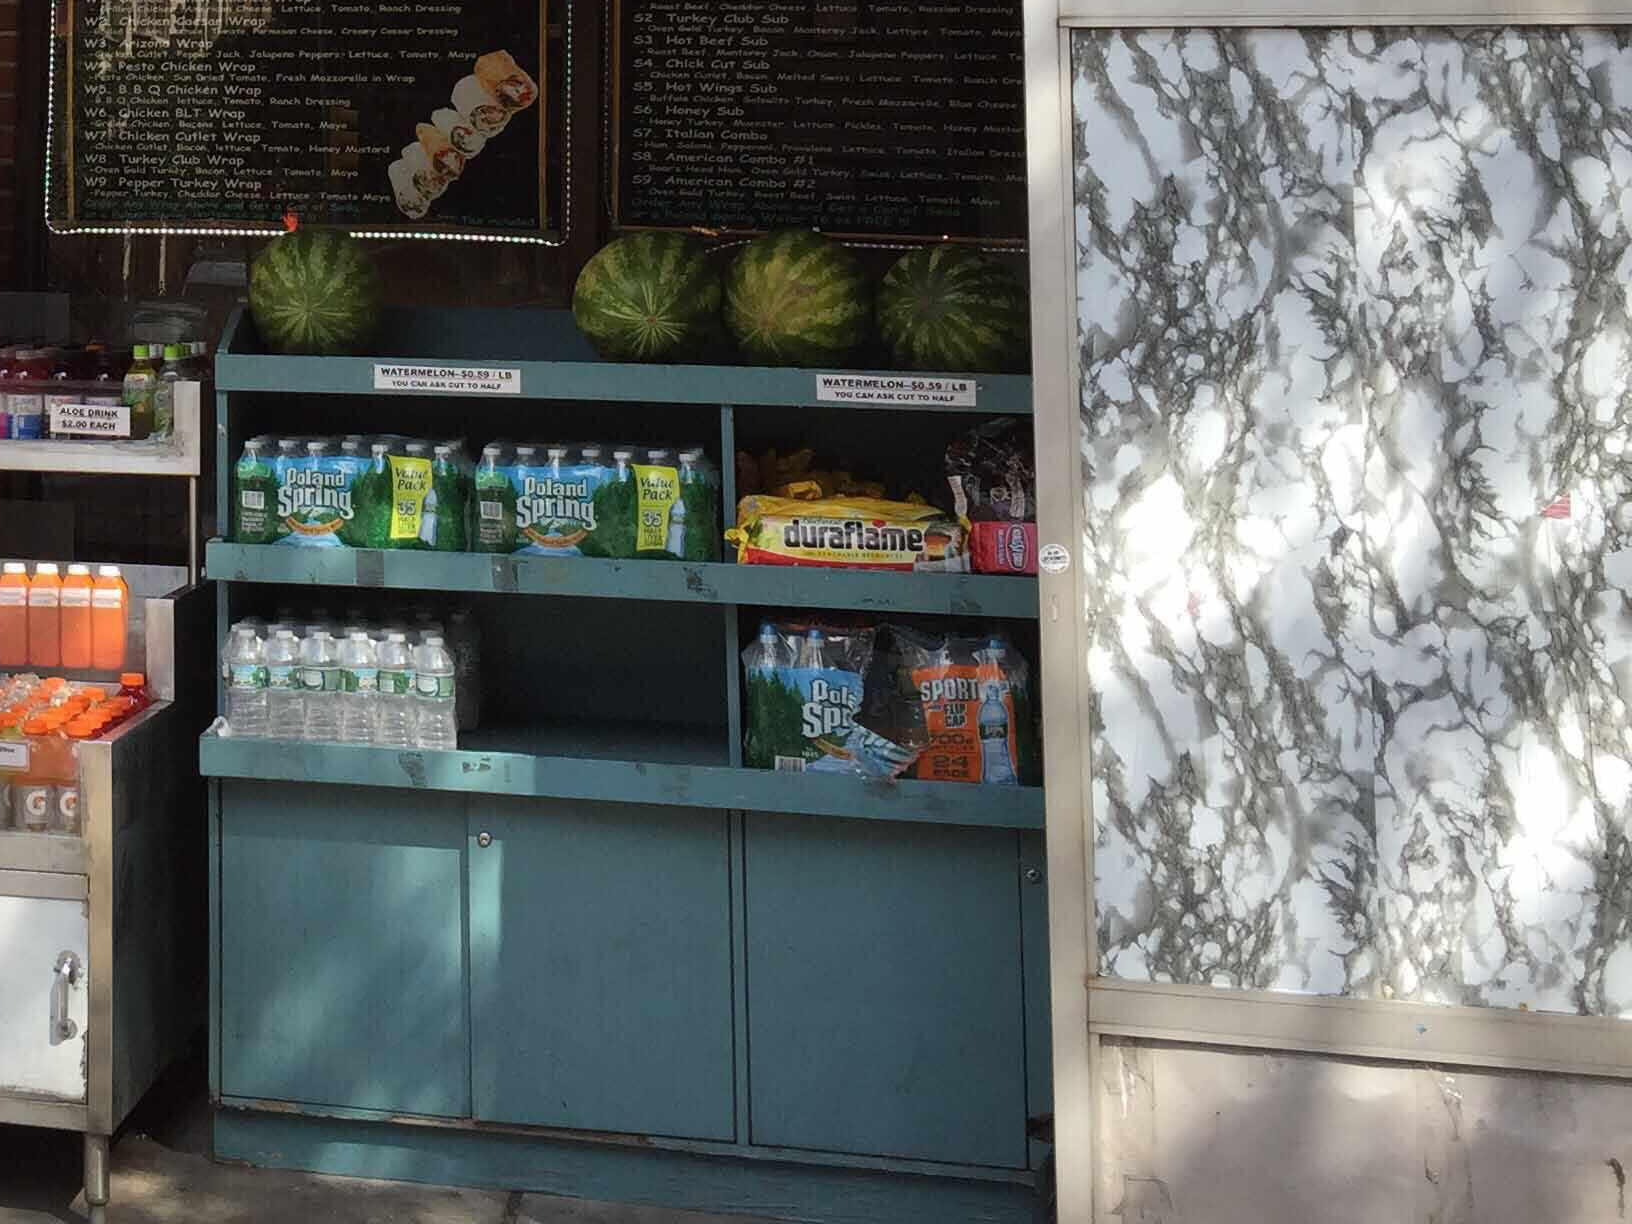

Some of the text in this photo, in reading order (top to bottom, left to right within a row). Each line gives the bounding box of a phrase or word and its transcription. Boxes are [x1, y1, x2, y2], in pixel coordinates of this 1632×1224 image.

[228, 17, 267, 29] Wrap
[665, 13, 718, 27] Turkey
[723, 13, 755, 23] Club
[760, 14, 789, 24] Sub
[176, 38, 214, 50] Wrap
[665, 35, 694, 45] Hot
[699, 35, 734, 45] Beef
[740, 36, 768, 46] Sub
[118, 62, 156, 72] Pesto
[160, 62, 212, 72] Chicken
[218, 62, 256, 74] Wrap
[665, 59, 704, 68] Chick
[742, 59, 770, 70] Sub
[166, 84, 218, 95] Chicken
[224, 84, 262, 97] Wrap
[665, 82, 693, 92] Hot
[699, 82, 744, 95] Wings
[749, 83, 778, 94] Sub
[84, 107, 246, 121] W6 Chicken BLT Wrap
[665, 105, 710, 117] Honey
[717, 106, 744, 116] Sub
[119, 131, 168, 141] Chicken
[175, 131, 216, 141] Cutlet
[223, 132, 261, 144] Wrap
[665, 128, 714, 138] Italian
[720, 128, 768, 140] Combo
[84, 154, 244, 167] W8 Turkey Club Wrap
[665, 152, 734, 163] American
[739, 152, 787, 164] Combo
[84, 177, 262, 191] W9 Pepper Turkey Wrap
[665, 175, 734, 186] American
[739, 176, 787, 188] Combo
[498, 371, 512, 380] LB
[952, 382, 968, 391] LB
[876, 392, 895, 400] ASK
[897, 393, 915, 401] CUT
[60, 407, 118, 417] ALOE DRINK
[62, 419, 116, 430] $2.00 EACH
[286, 467, 345, 487] Poland
[397, 479, 427, 491] Pack
[524, 476, 587, 496] Poland
[643, 489, 672, 501] Pack
[277, 484, 355, 520] Spring
[515, 494, 598, 531] Spring
[784, 519, 924, 552] duraflame
[920, 678, 978, 702] SPORT
[26, 789, 47, 816] G
